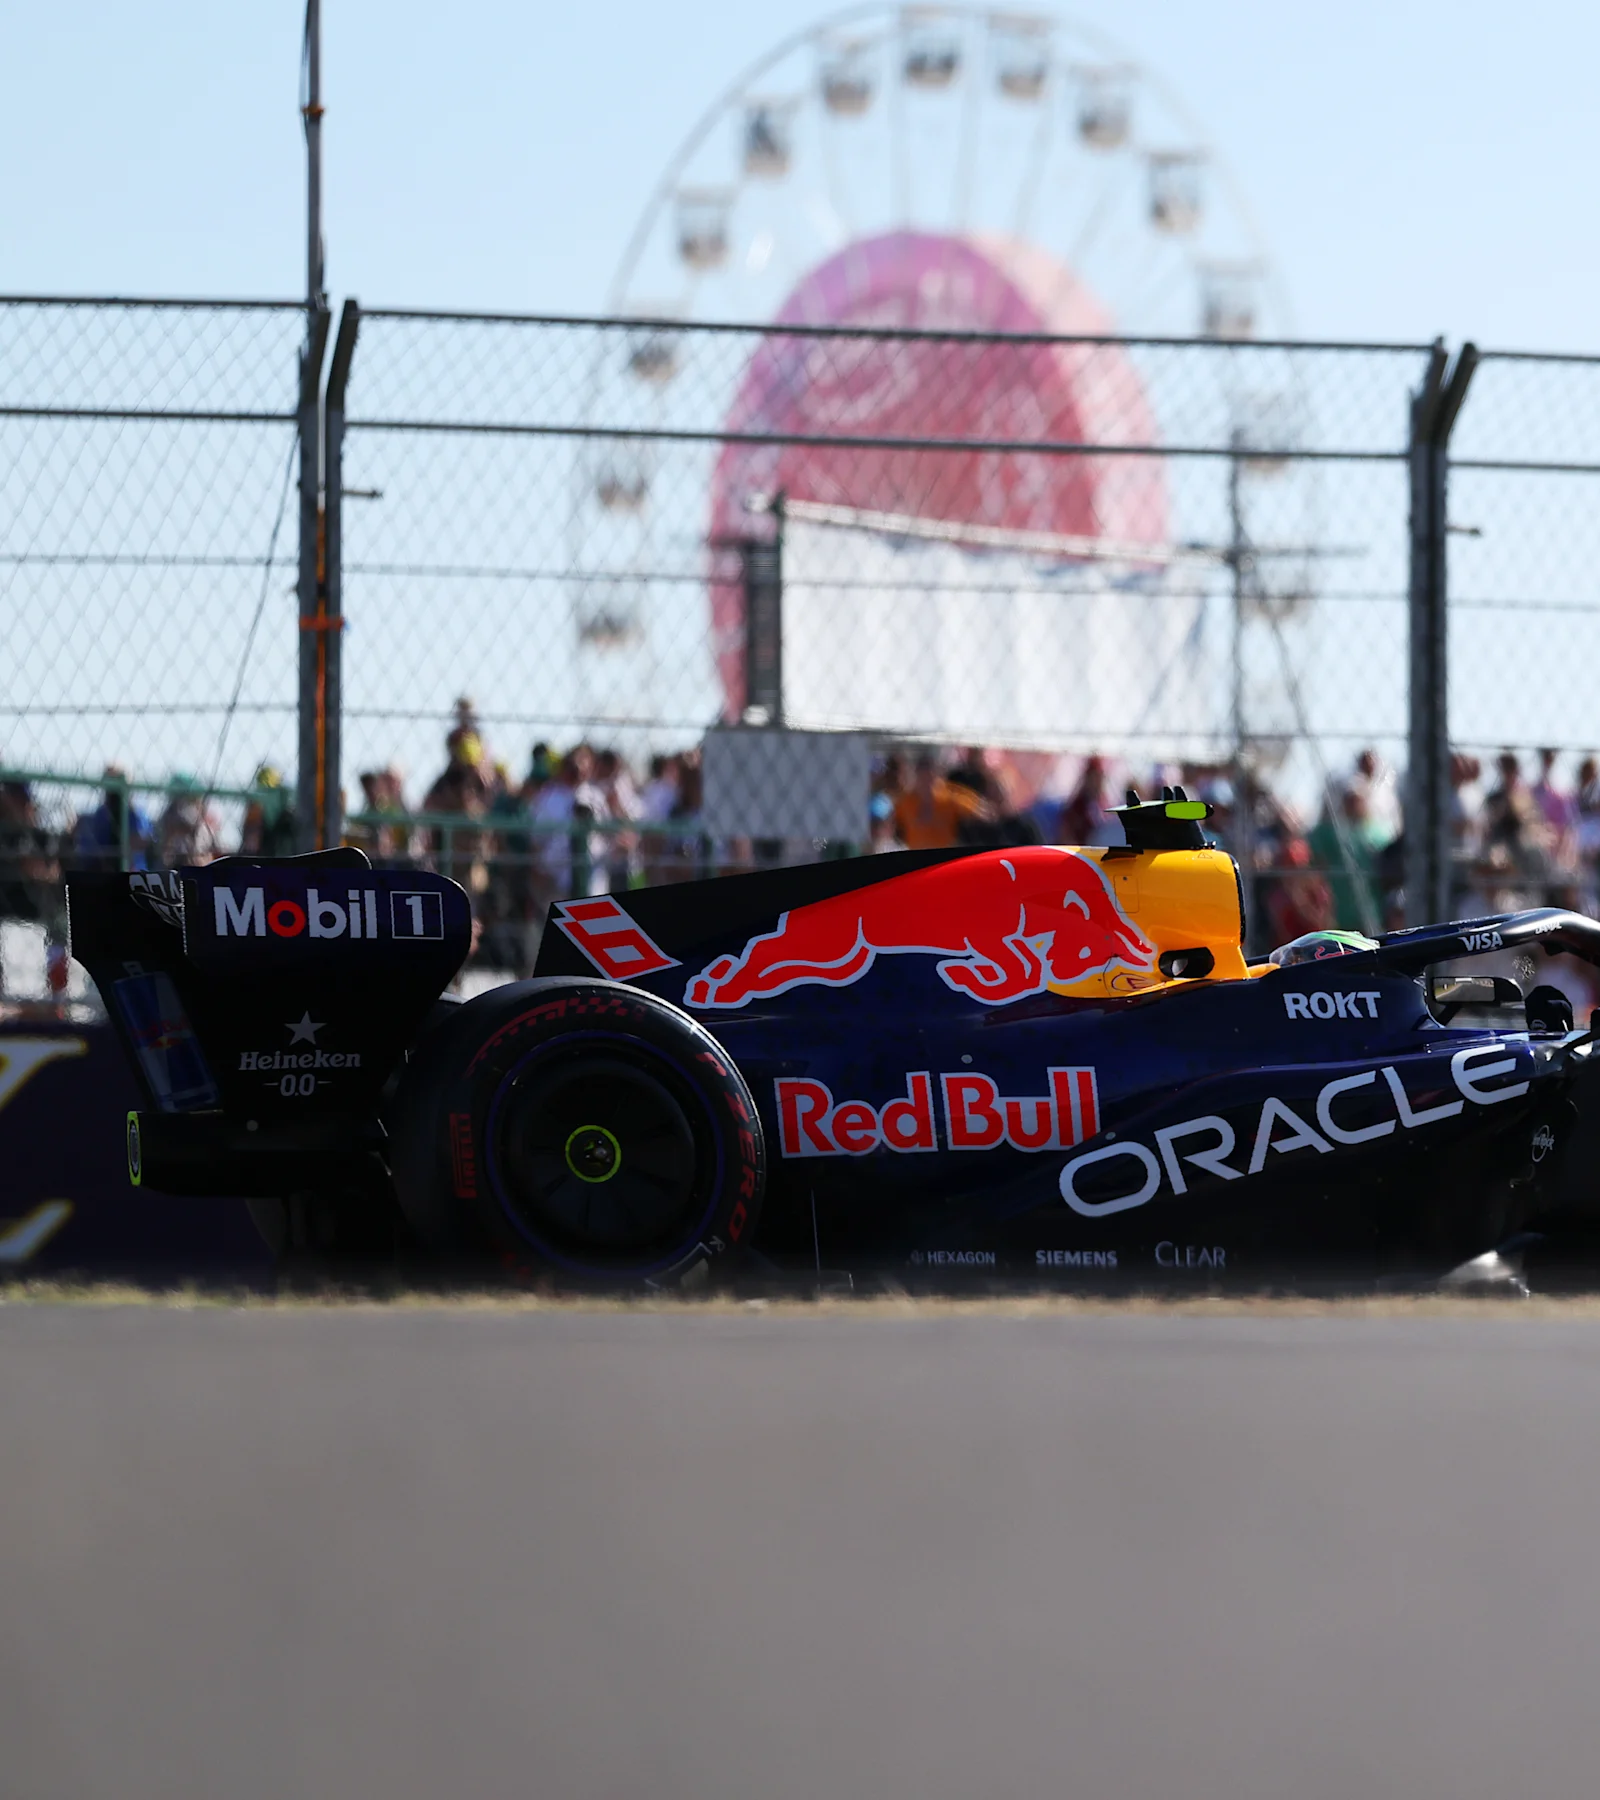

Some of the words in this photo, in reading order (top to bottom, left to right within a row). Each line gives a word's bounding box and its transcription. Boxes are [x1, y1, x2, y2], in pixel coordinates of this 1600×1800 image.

[213, 886, 378, 939] Mobil
[404, 895, 425, 936] 1
[552, 895, 682, 980] 6
[1458, 931, 1504, 952] VISA
[1282, 990, 1381, 1021] ROKT
[238, 1049, 362, 1072] Heineken
[774, 1071, 938, 1158] Red
[940, 1066, 1100, 1152] Bull
[1058, 1044, 1531, 1218] ORACLE
[449, 1112, 477, 1199] PIRELLI
[724, 1090, 757, 1242] ZERO
[927, 1249, 996, 1266] HEXAGON
[1035, 1249, 1119, 1268] SIEMENS
[1154, 1239, 1227, 1268] CLEAR
